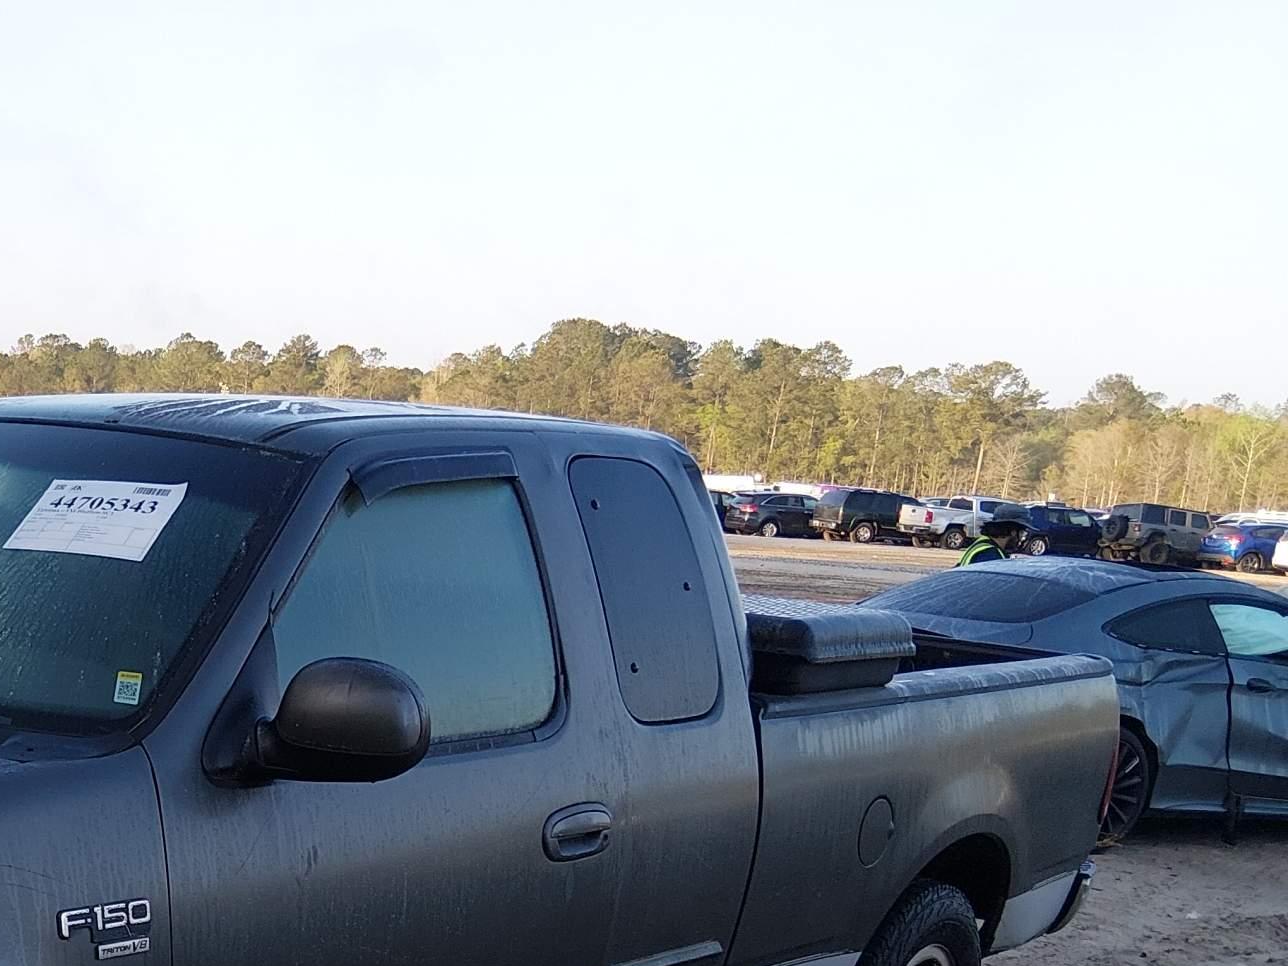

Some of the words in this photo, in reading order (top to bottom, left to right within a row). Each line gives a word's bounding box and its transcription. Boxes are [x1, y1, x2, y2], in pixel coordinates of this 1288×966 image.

[49, 495, 159, 514] 44705343
[100, 943, 132, 956] TRITON
[132, 938, 148, 953] V8
